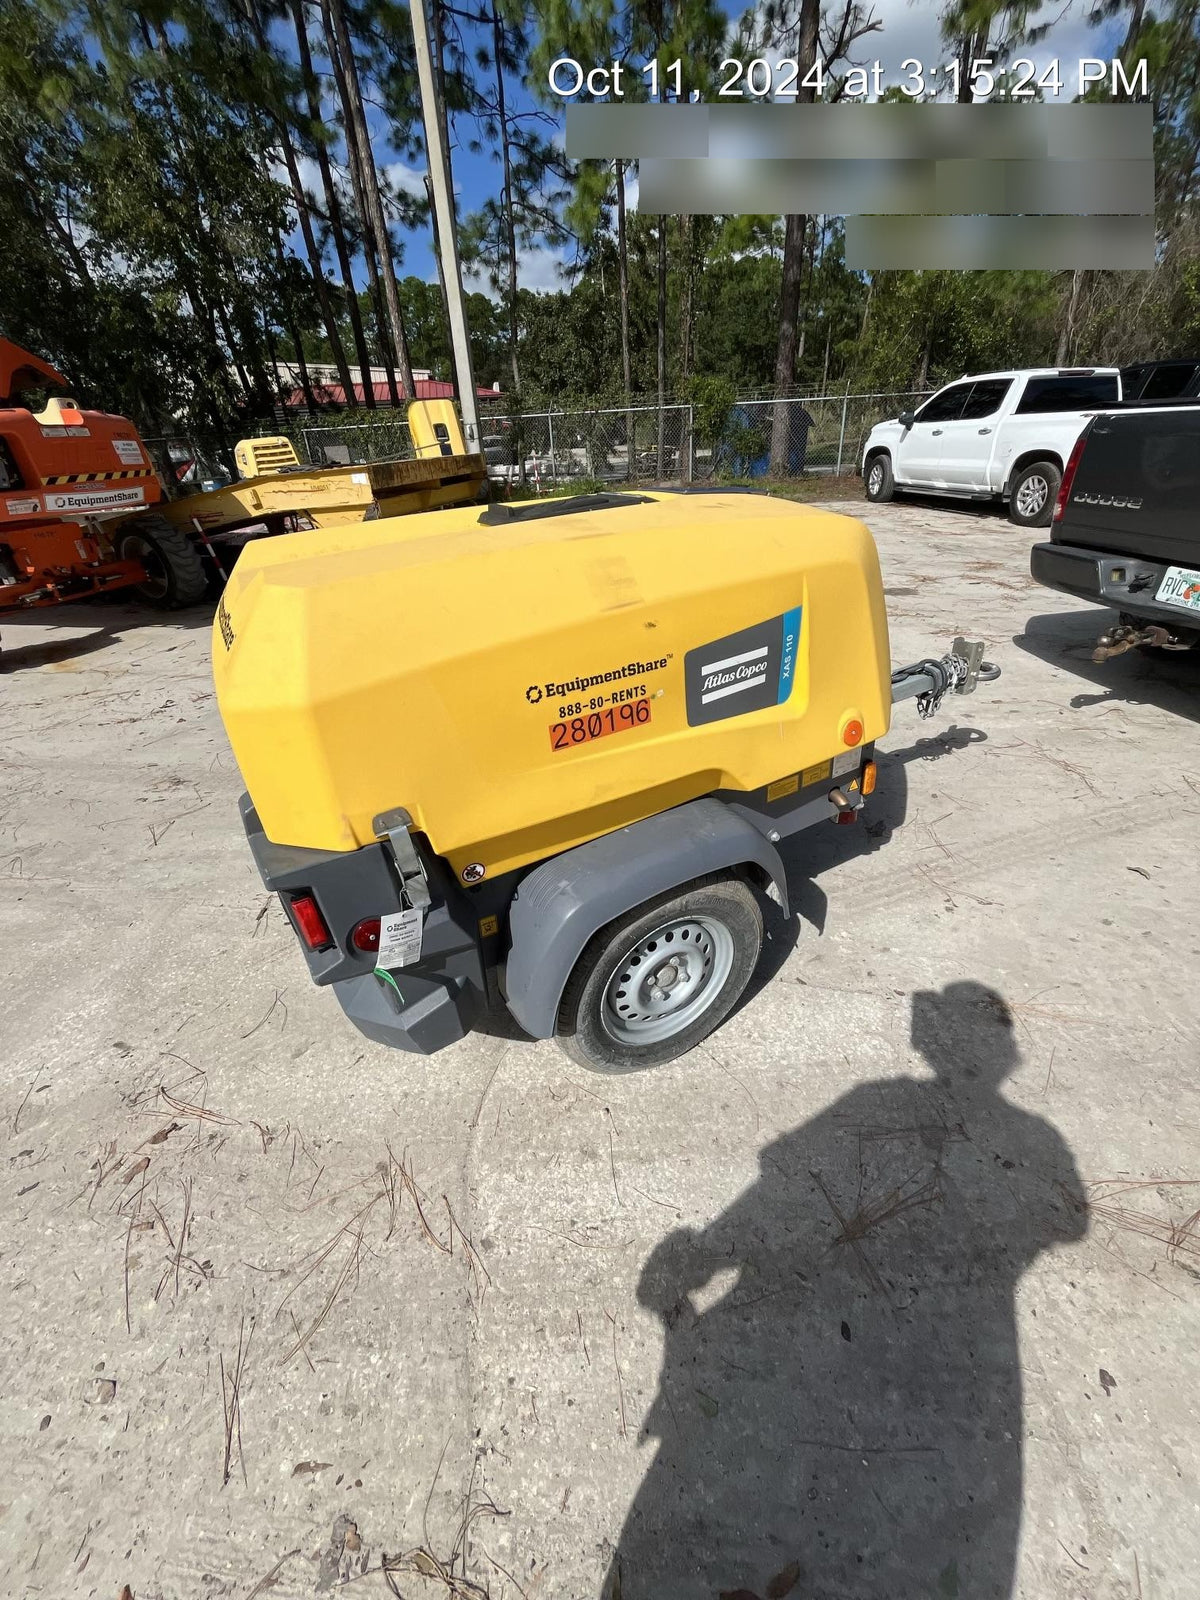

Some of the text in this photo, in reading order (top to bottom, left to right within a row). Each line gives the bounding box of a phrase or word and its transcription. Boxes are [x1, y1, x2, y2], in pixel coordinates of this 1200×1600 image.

[67, 491, 139, 507] EquipmentShare
[1162, 576, 1188, 597] RVC
[785, 634, 794, 653] 110
[545, 657, 668, 698] EquipmentShare
[701, 661, 768, 692] Atlas Copco
[558, 684, 647, 719] 888-80-RENTS
[552, 698, 650, 750] 280196
